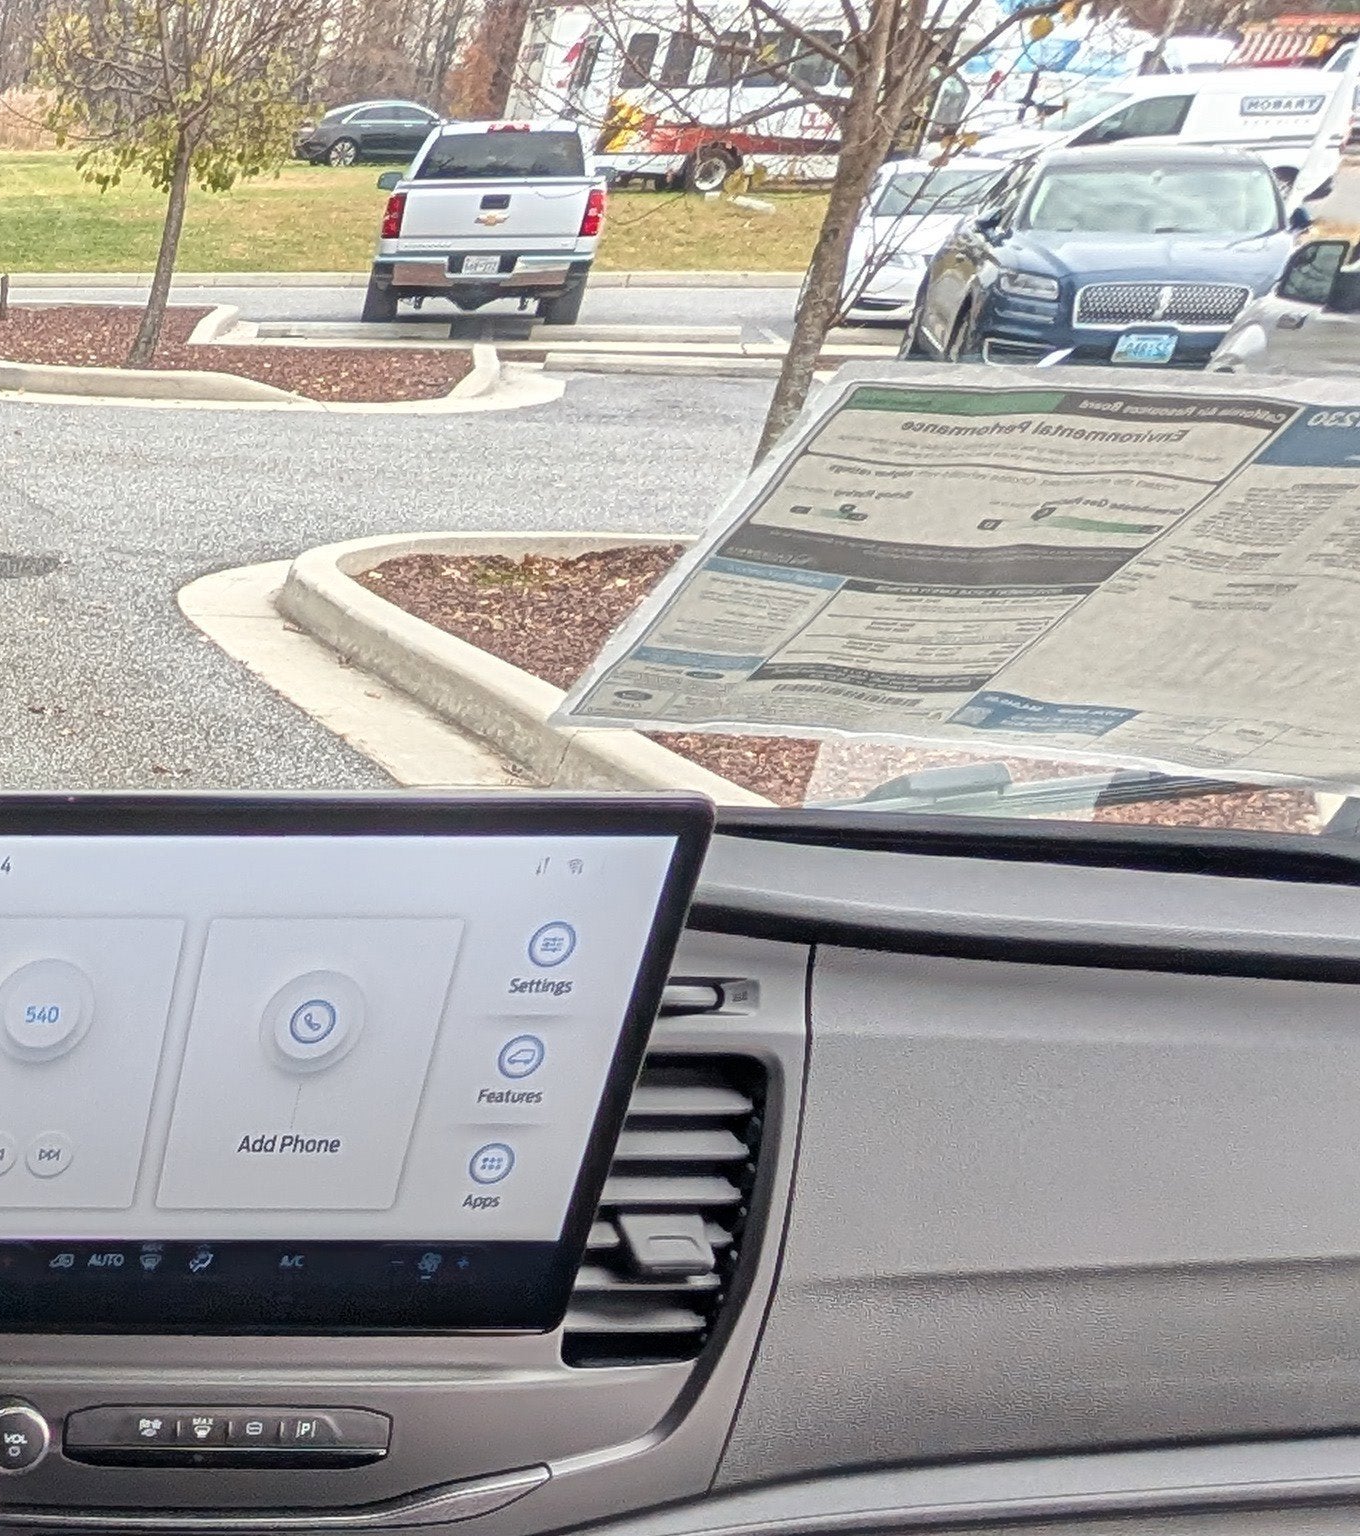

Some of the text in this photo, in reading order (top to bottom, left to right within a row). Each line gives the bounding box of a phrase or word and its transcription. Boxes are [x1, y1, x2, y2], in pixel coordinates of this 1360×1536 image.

[1247, 99, 1318, 110] HOBART
[508, 976, 573, 997] Settings
[25, 1005, 60, 1025] 540
[476, 1087, 543, 1106] Features
[237, 1133, 341, 1156] Add Phone
[462, 1191, 501, 1211] Apps
[87, 1253, 125, 1267] AUTO
[279, 1254, 305, 1268] A/C
[3, 1433, 28, 1445] VOL
